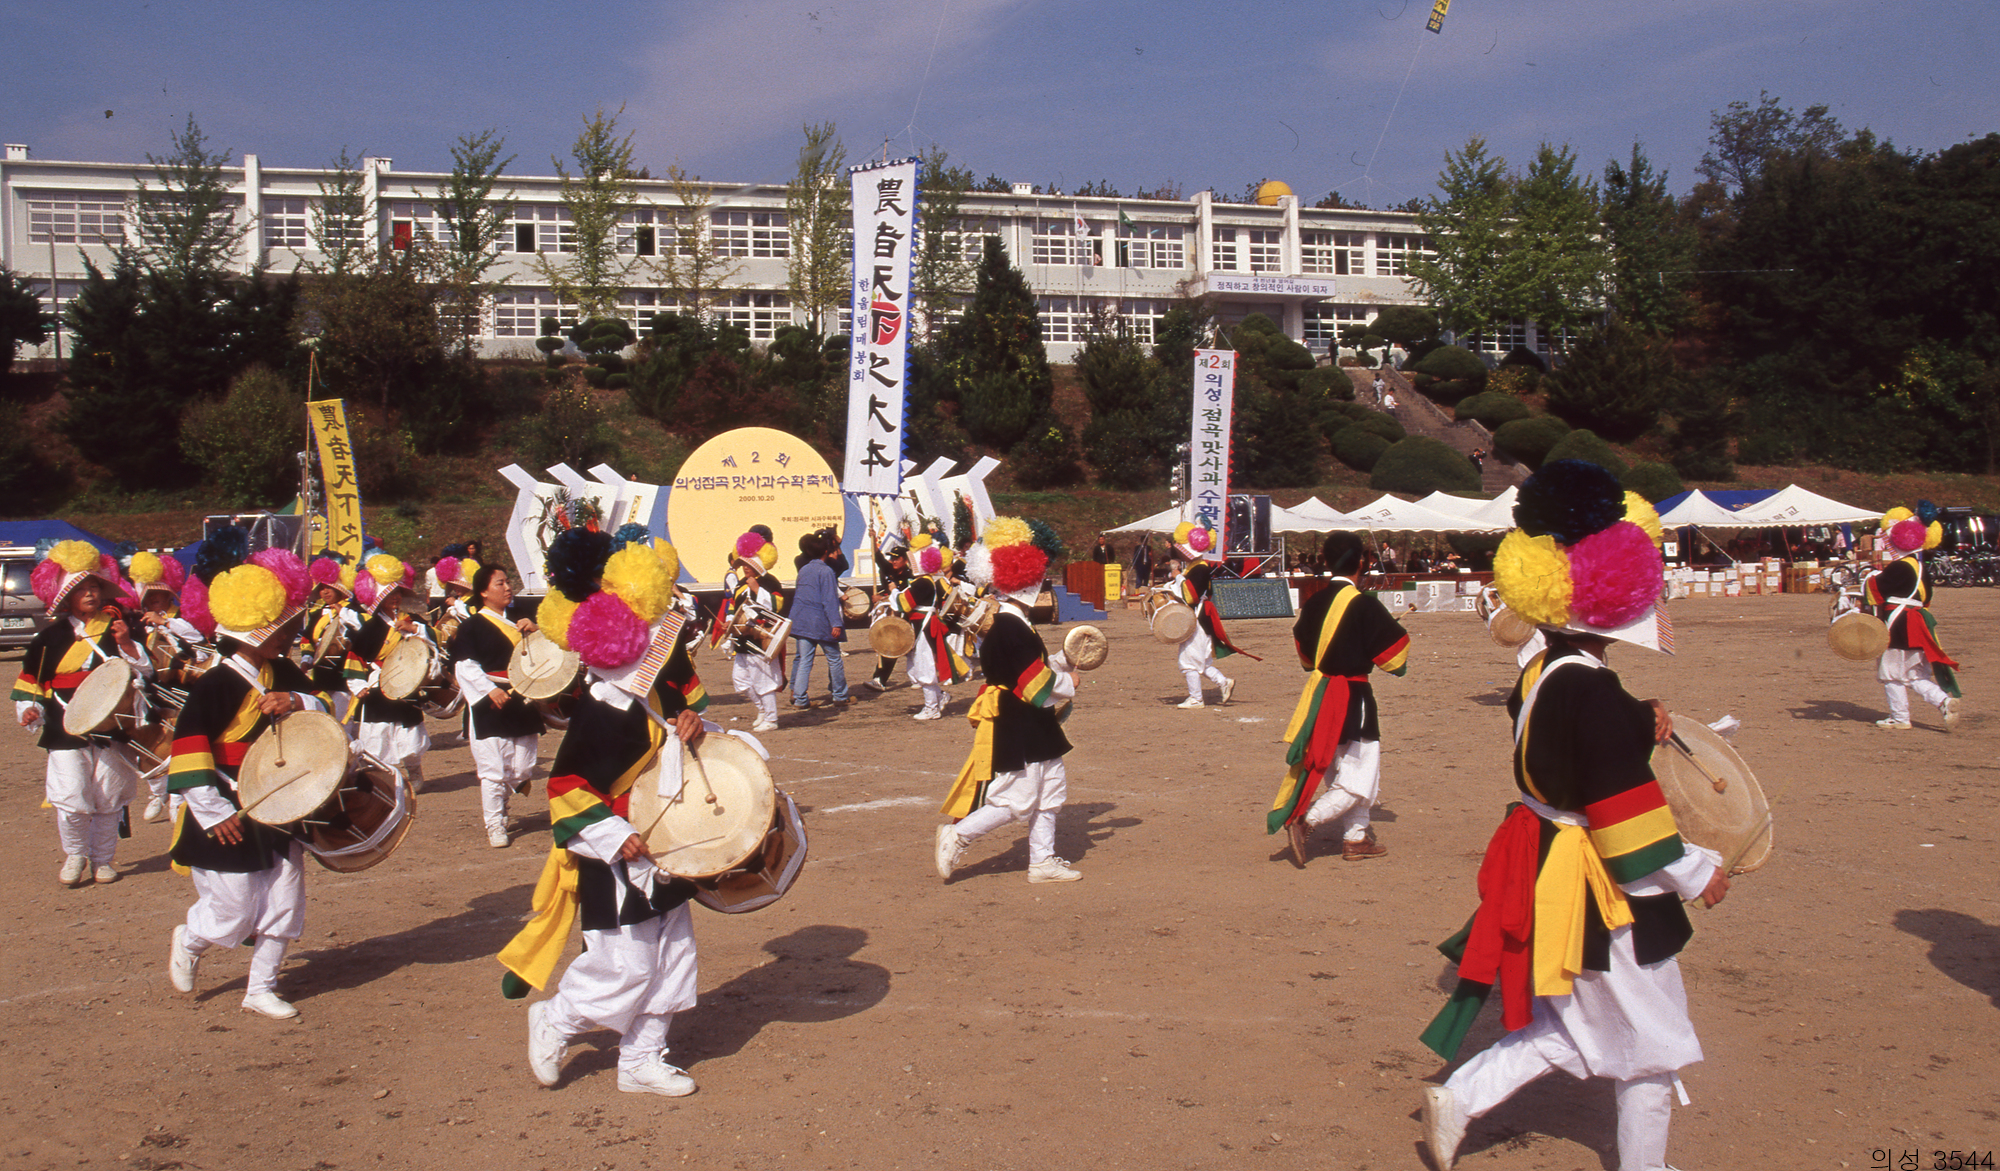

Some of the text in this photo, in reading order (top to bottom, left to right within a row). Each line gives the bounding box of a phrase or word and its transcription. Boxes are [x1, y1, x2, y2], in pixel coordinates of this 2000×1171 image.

[1217, 281, 1328, 295] 정직하고 창의적인 사람이 되자
[1199, 355, 1231, 370] 제2회
[721, 451, 791, 468] 제 2 회
[1431, 585, 1437, 596] 1
[1395, 593, 1402, 604] 2
[1467, 599, 1473, 609] 3
